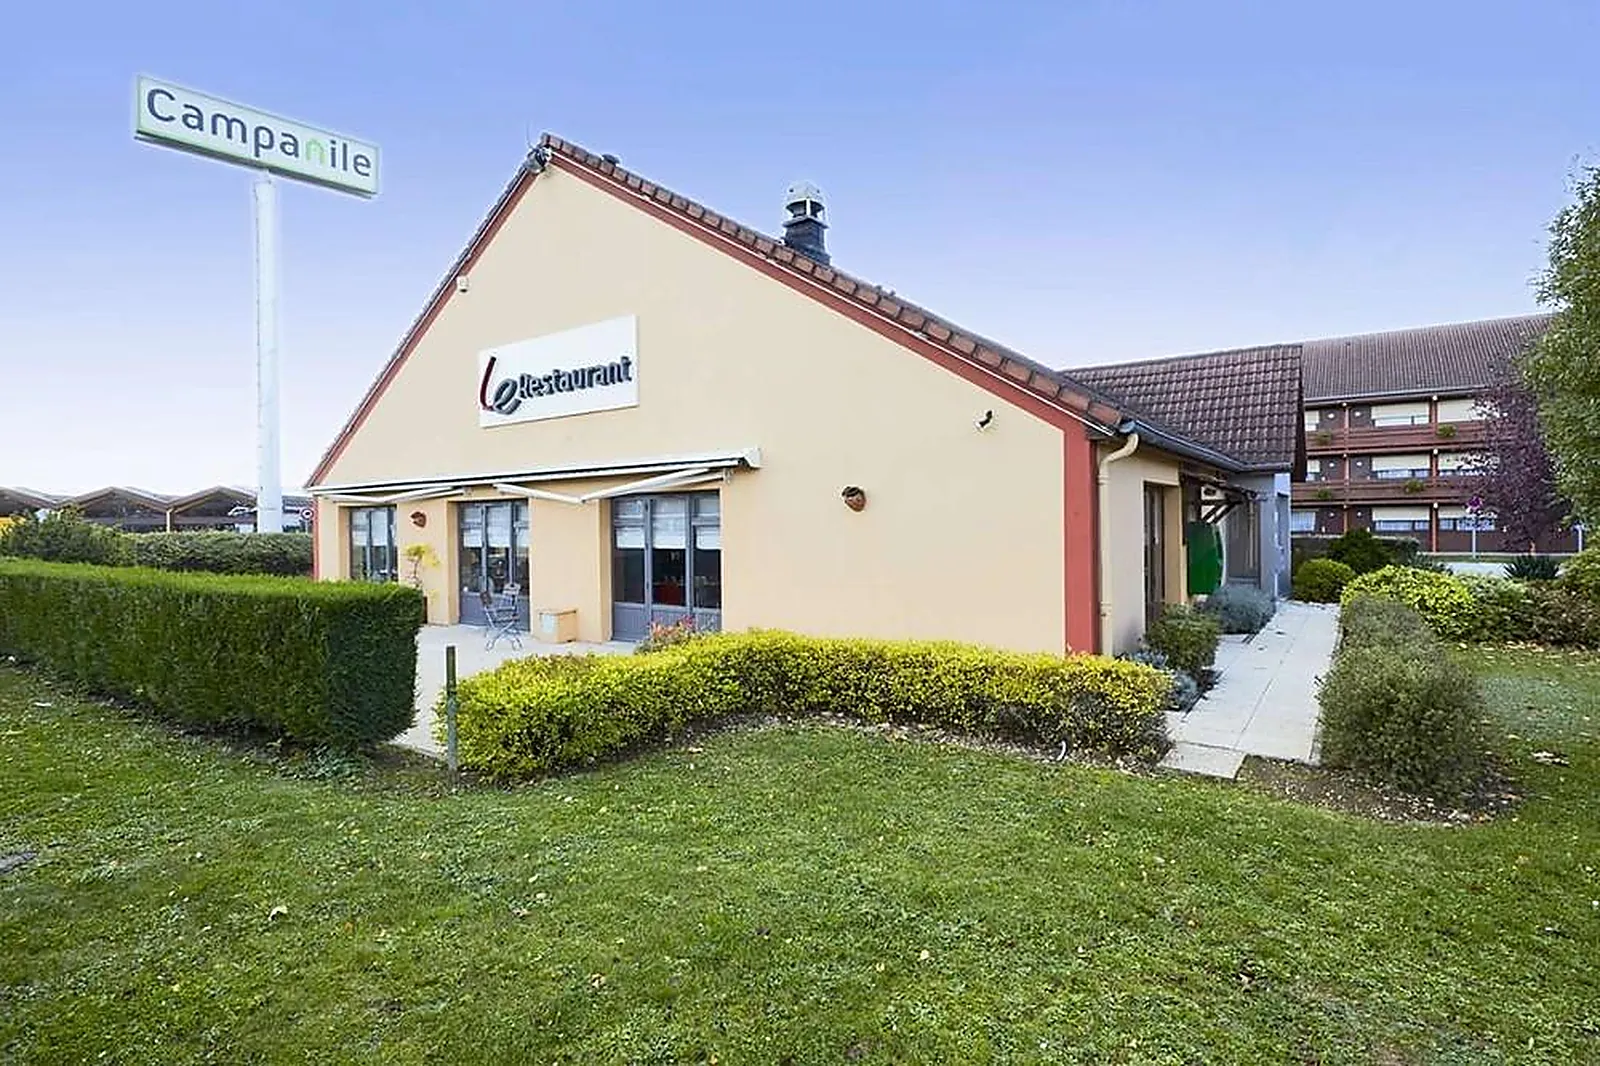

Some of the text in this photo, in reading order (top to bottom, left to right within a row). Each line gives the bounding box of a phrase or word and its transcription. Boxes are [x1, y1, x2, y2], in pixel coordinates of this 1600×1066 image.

[147, 88, 371, 177] Campanile
[480, 356, 632, 415] Le Restaurant
